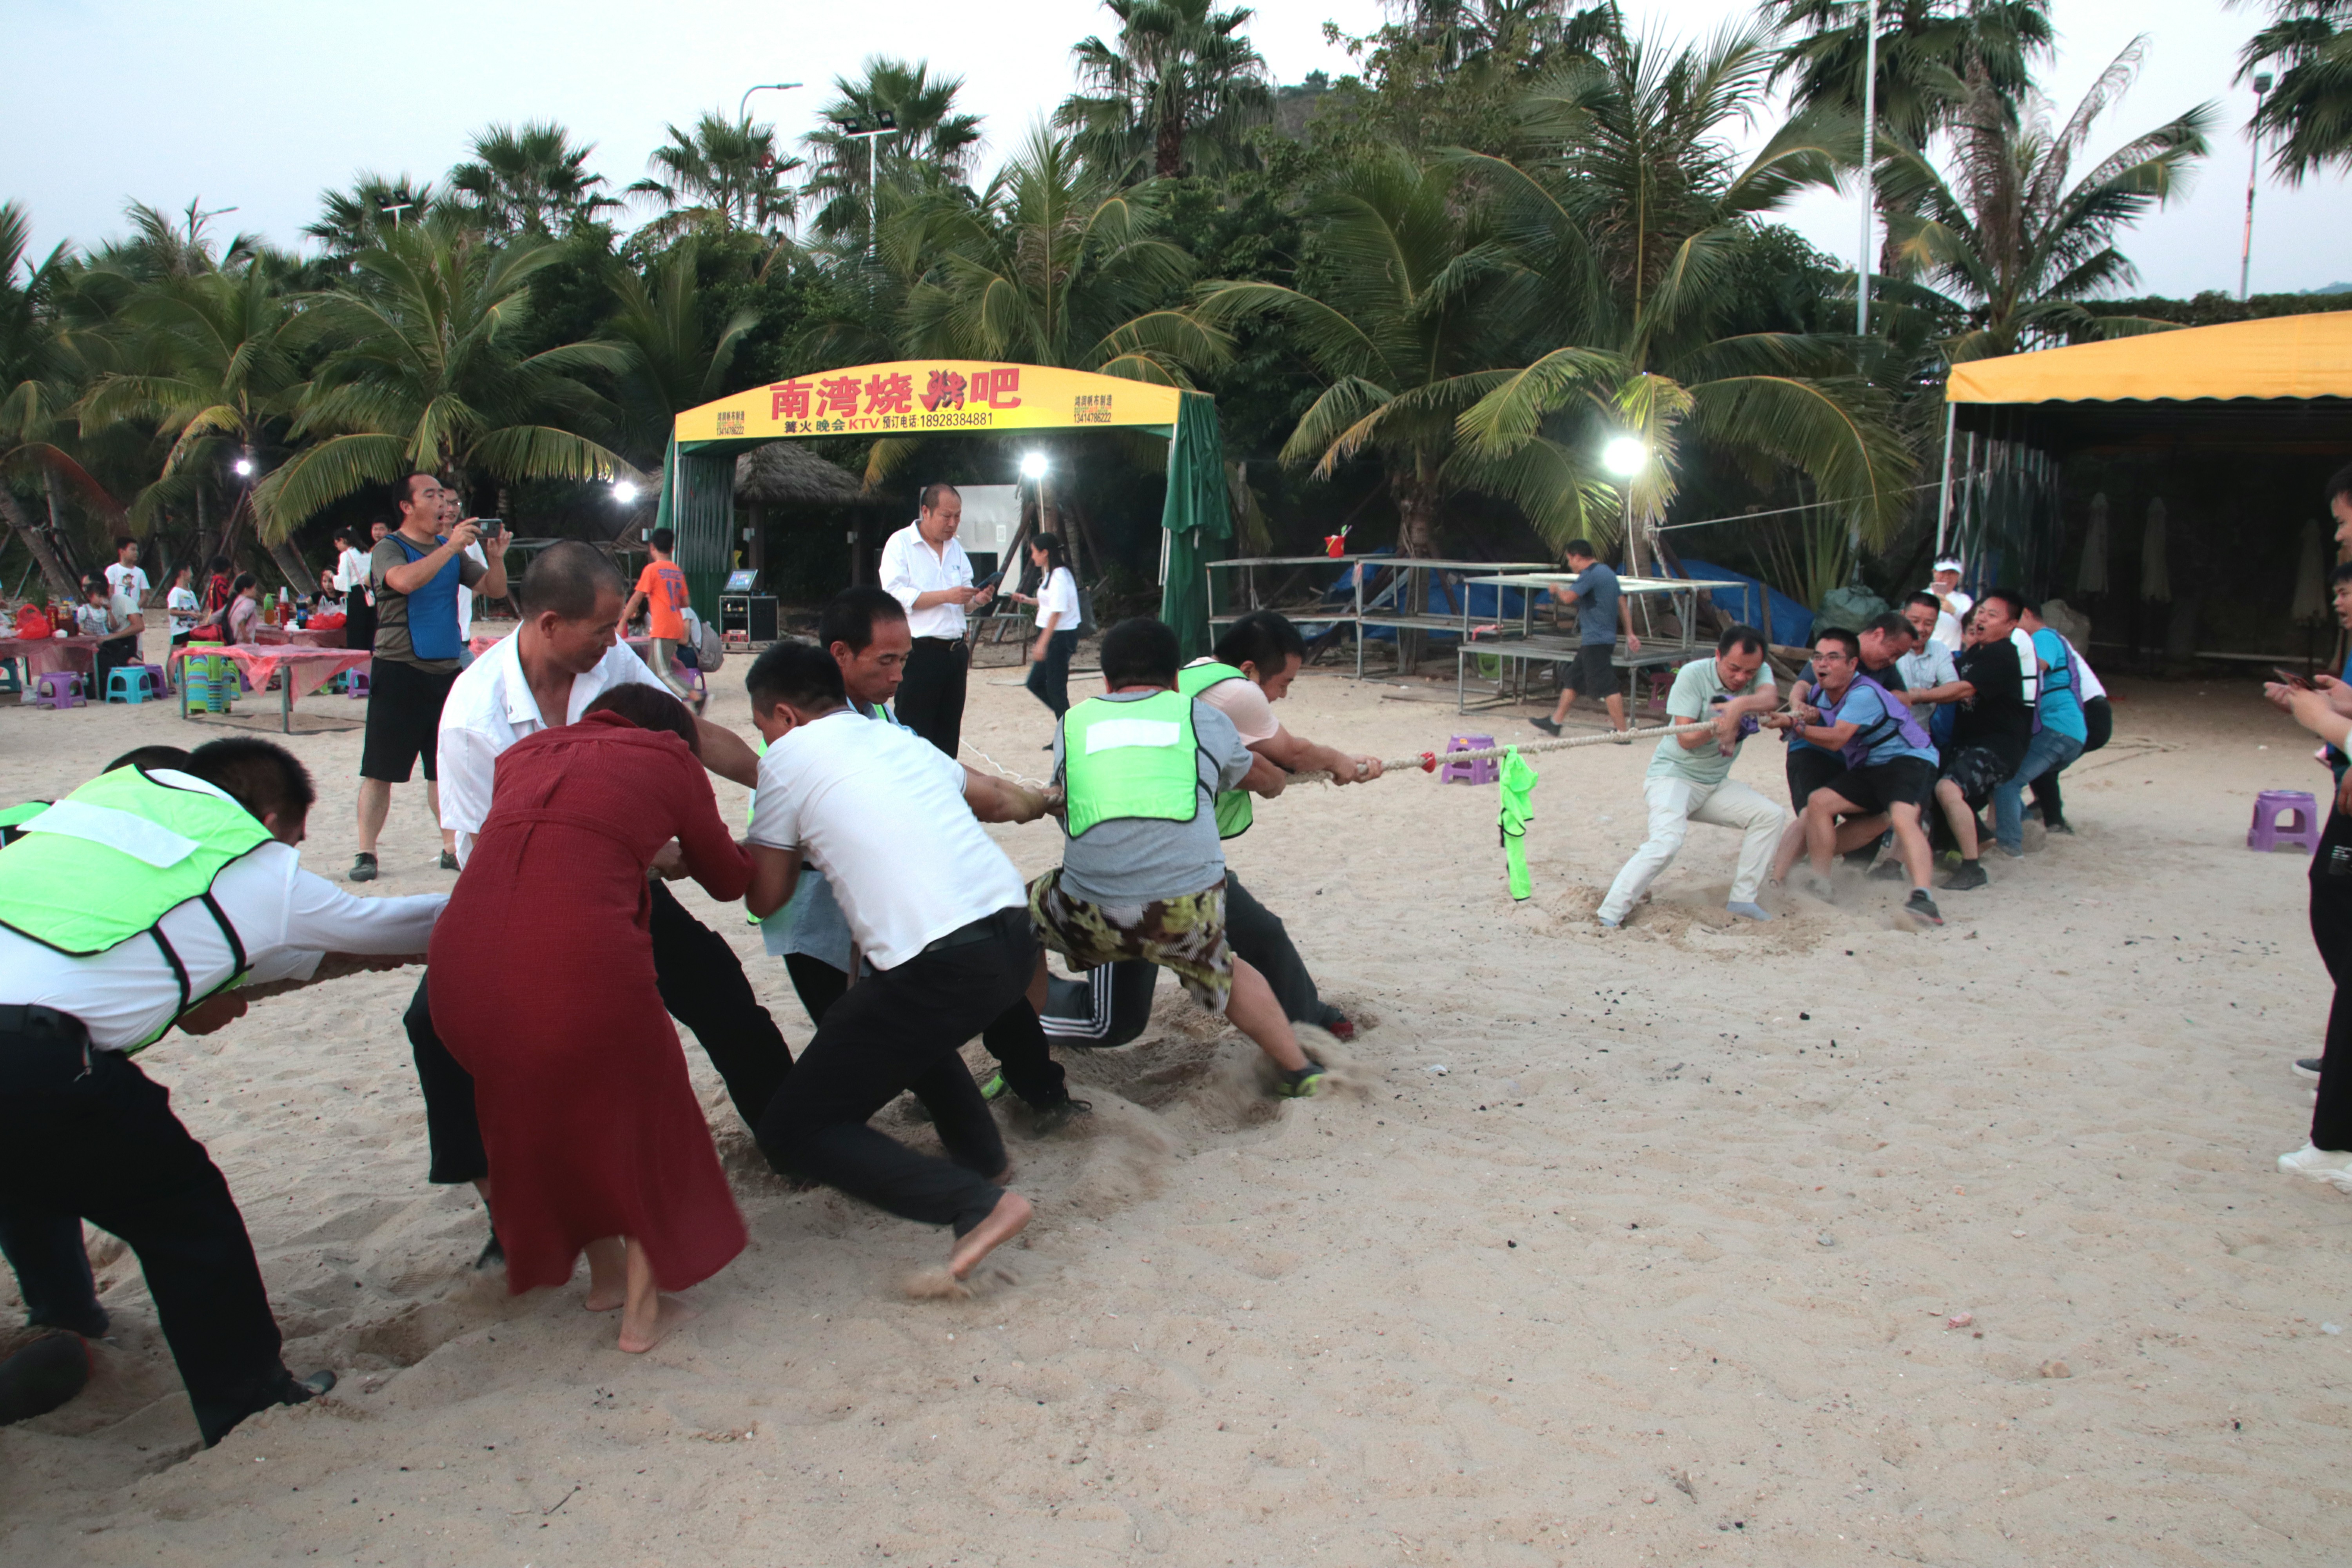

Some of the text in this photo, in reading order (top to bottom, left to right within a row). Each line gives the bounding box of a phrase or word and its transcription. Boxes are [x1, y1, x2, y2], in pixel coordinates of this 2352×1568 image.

[769, 368, 1022, 420] 南湾烧烤吧
[849, 417, 880, 430] KTV
[1074, 412, 1112, 423] 13414786222
